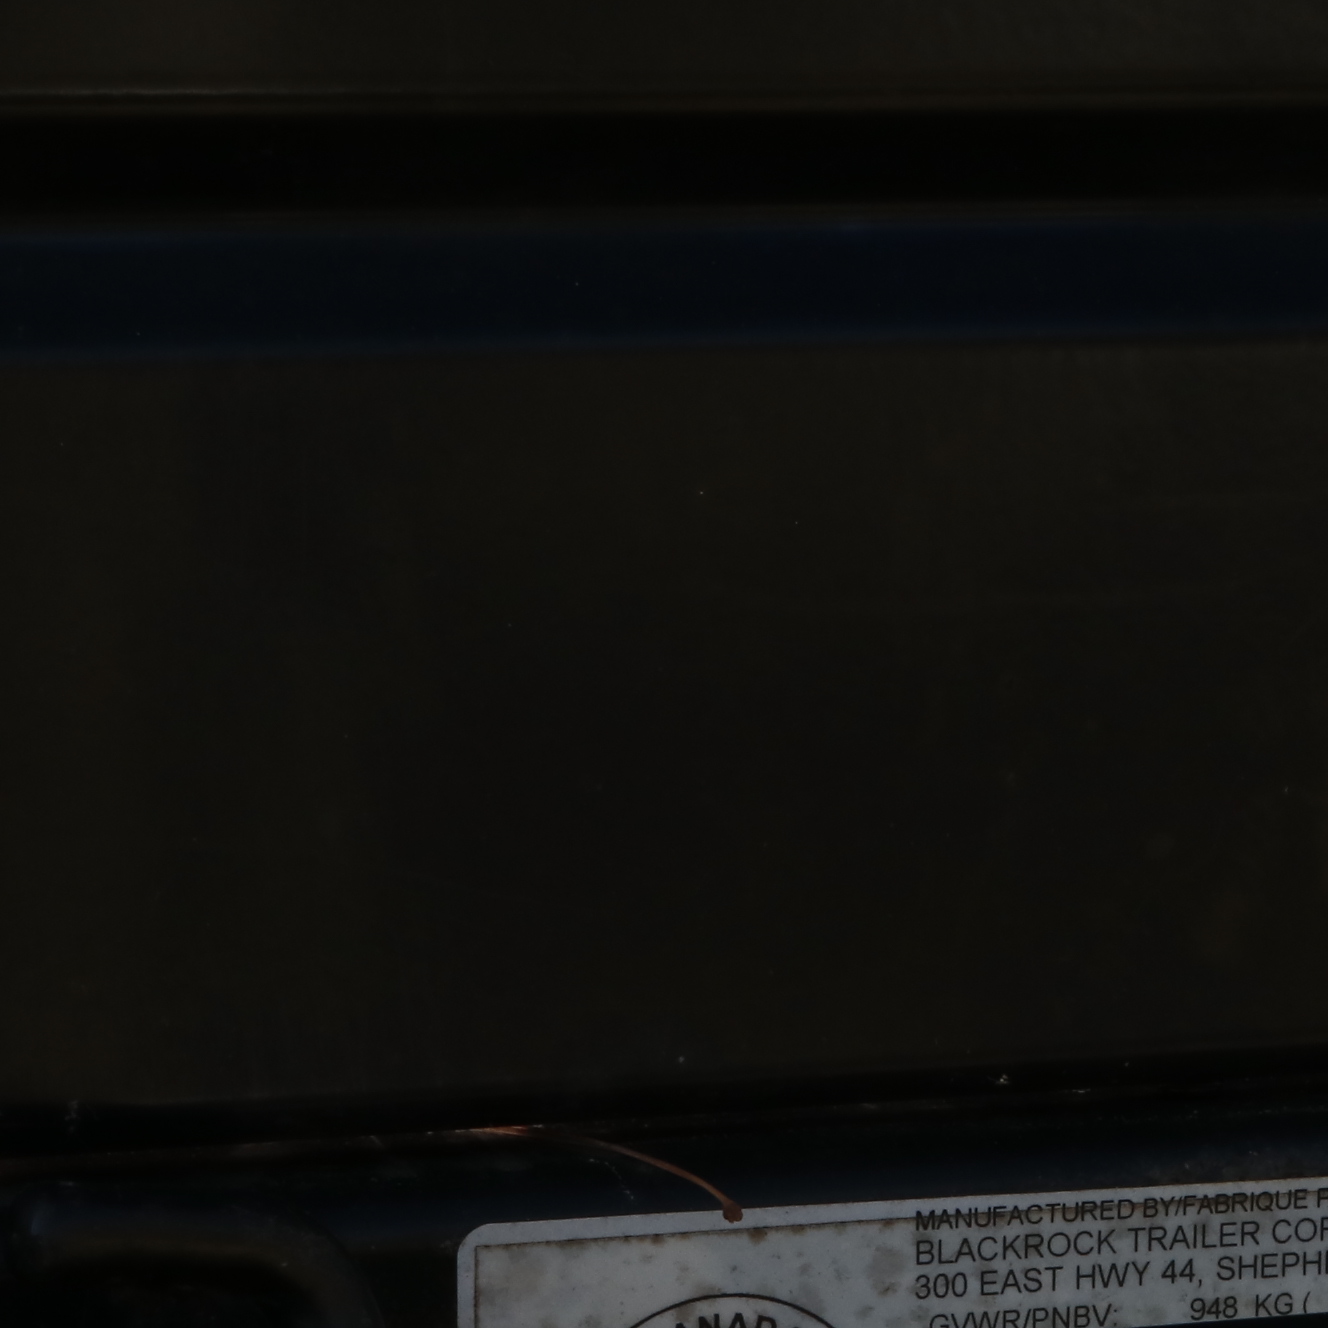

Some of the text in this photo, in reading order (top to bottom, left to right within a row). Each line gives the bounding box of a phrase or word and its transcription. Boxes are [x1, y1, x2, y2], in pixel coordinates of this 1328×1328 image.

[915, 1198, 1135, 1231] MANUFACTURED
[1142, 1188, 1310, 1219] BY/FABRIQUE
[915, 1229, 1117, 1266] BLACKROCK
[1127, 1220, 1260, 1253] TRAILER
[915, 1272, 968, 1300] 300
[980, 1266, 1064, 1296] EAST
[1076, 1261, 1151, 1290] HWY
[1161, 1258, 1202, 1288] 44,
[1190, 1295, 1238, 1320] 948
[1255, 1292, 1293, 1315] KG
